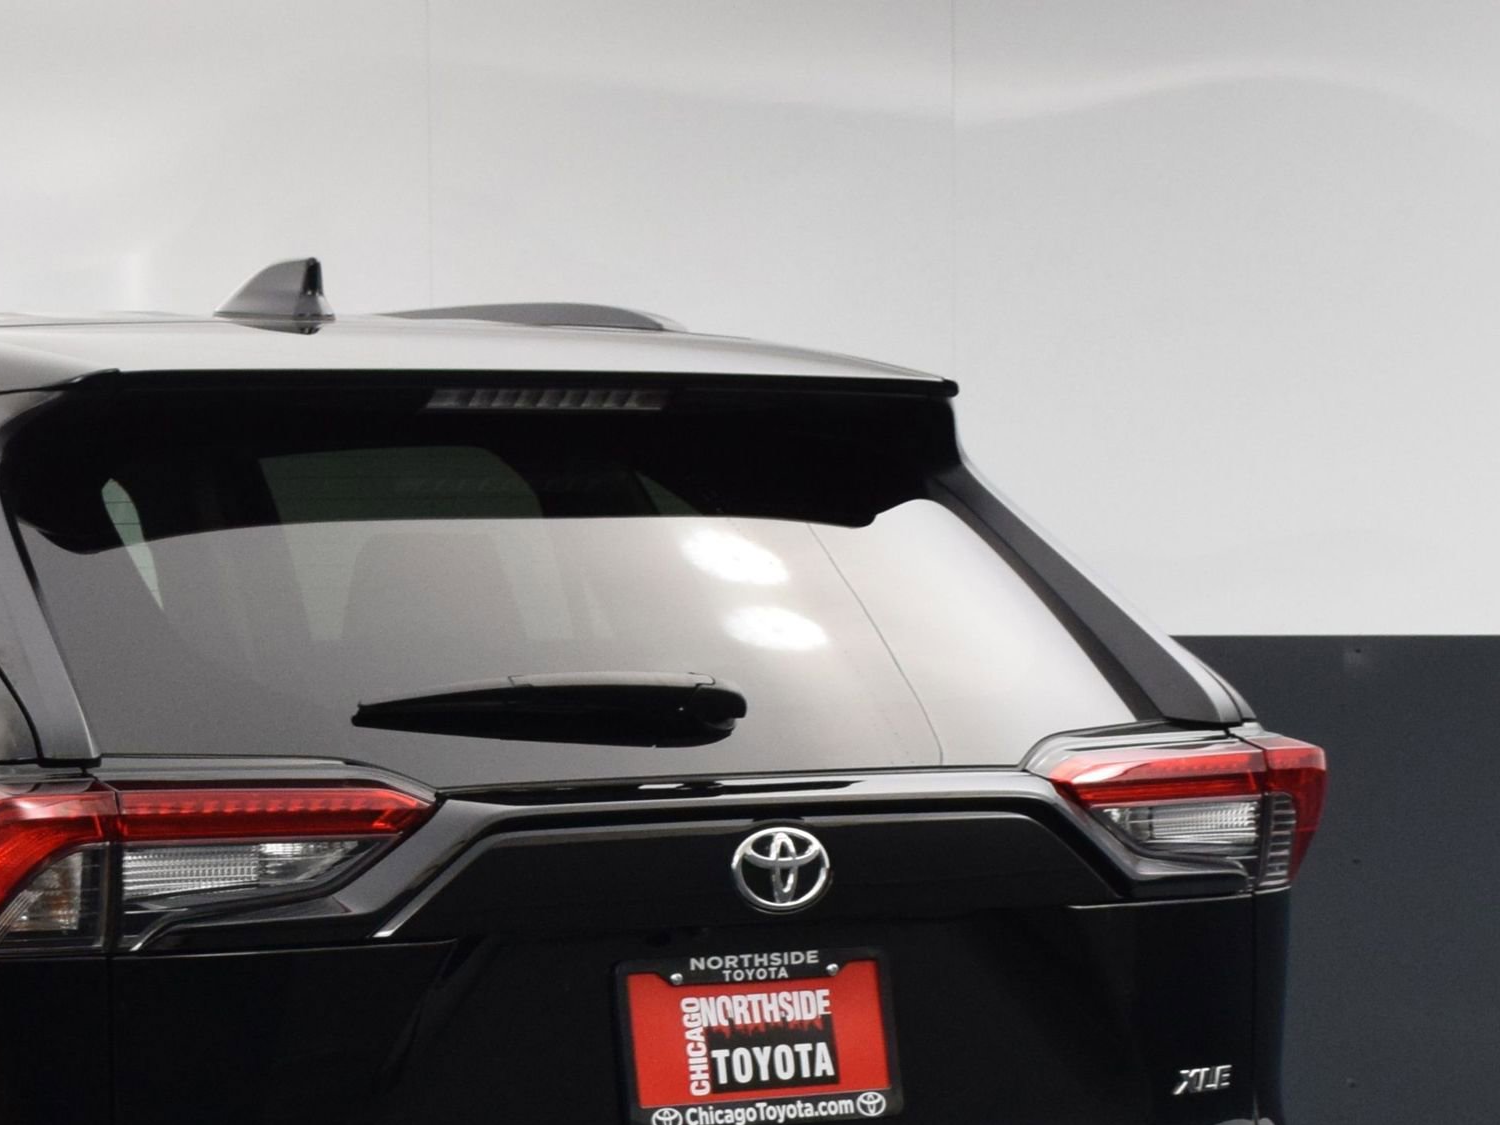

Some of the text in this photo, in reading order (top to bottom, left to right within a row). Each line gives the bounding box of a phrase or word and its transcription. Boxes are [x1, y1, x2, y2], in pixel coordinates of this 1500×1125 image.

[689, 950, 819, 971] NORTHSIDE
[722, 967, 789, 982] TOYOTA
[699, 989, 831, 1027] NORTHSIDE
[680, 997, 712, 1096] CHICAGO
[711, 1042, 835, 1084] TOYOTA
